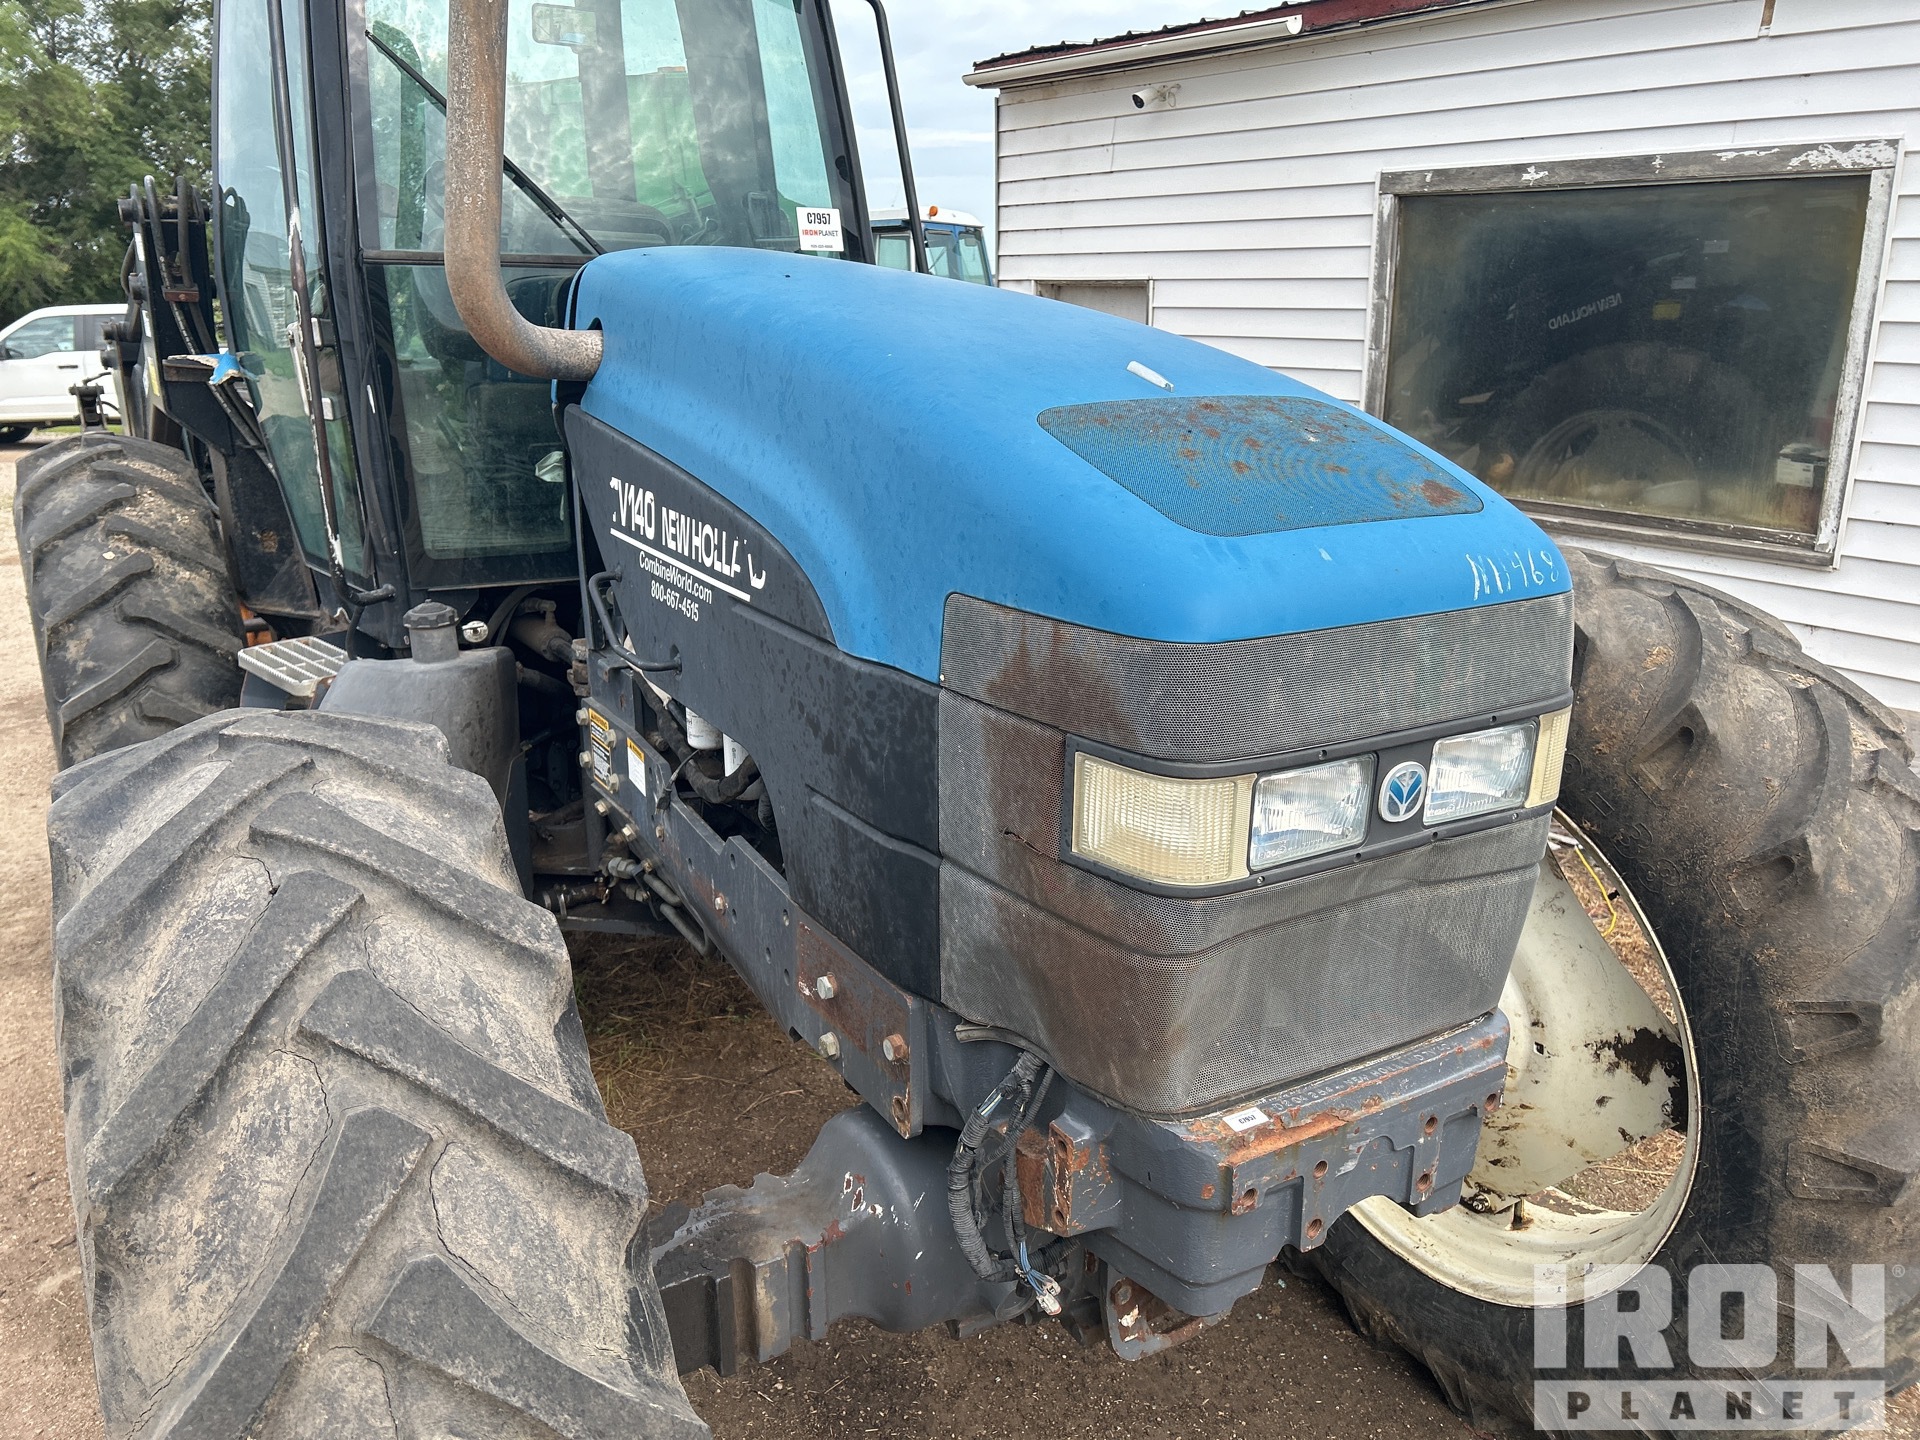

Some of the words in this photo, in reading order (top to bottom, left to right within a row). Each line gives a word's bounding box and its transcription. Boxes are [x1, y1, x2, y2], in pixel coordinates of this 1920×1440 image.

[807, 212, 831, 225] C7957
[639, 550, 712, 605] CombineWorld.com
[650, 579, 699, 622] 800-667-4515
